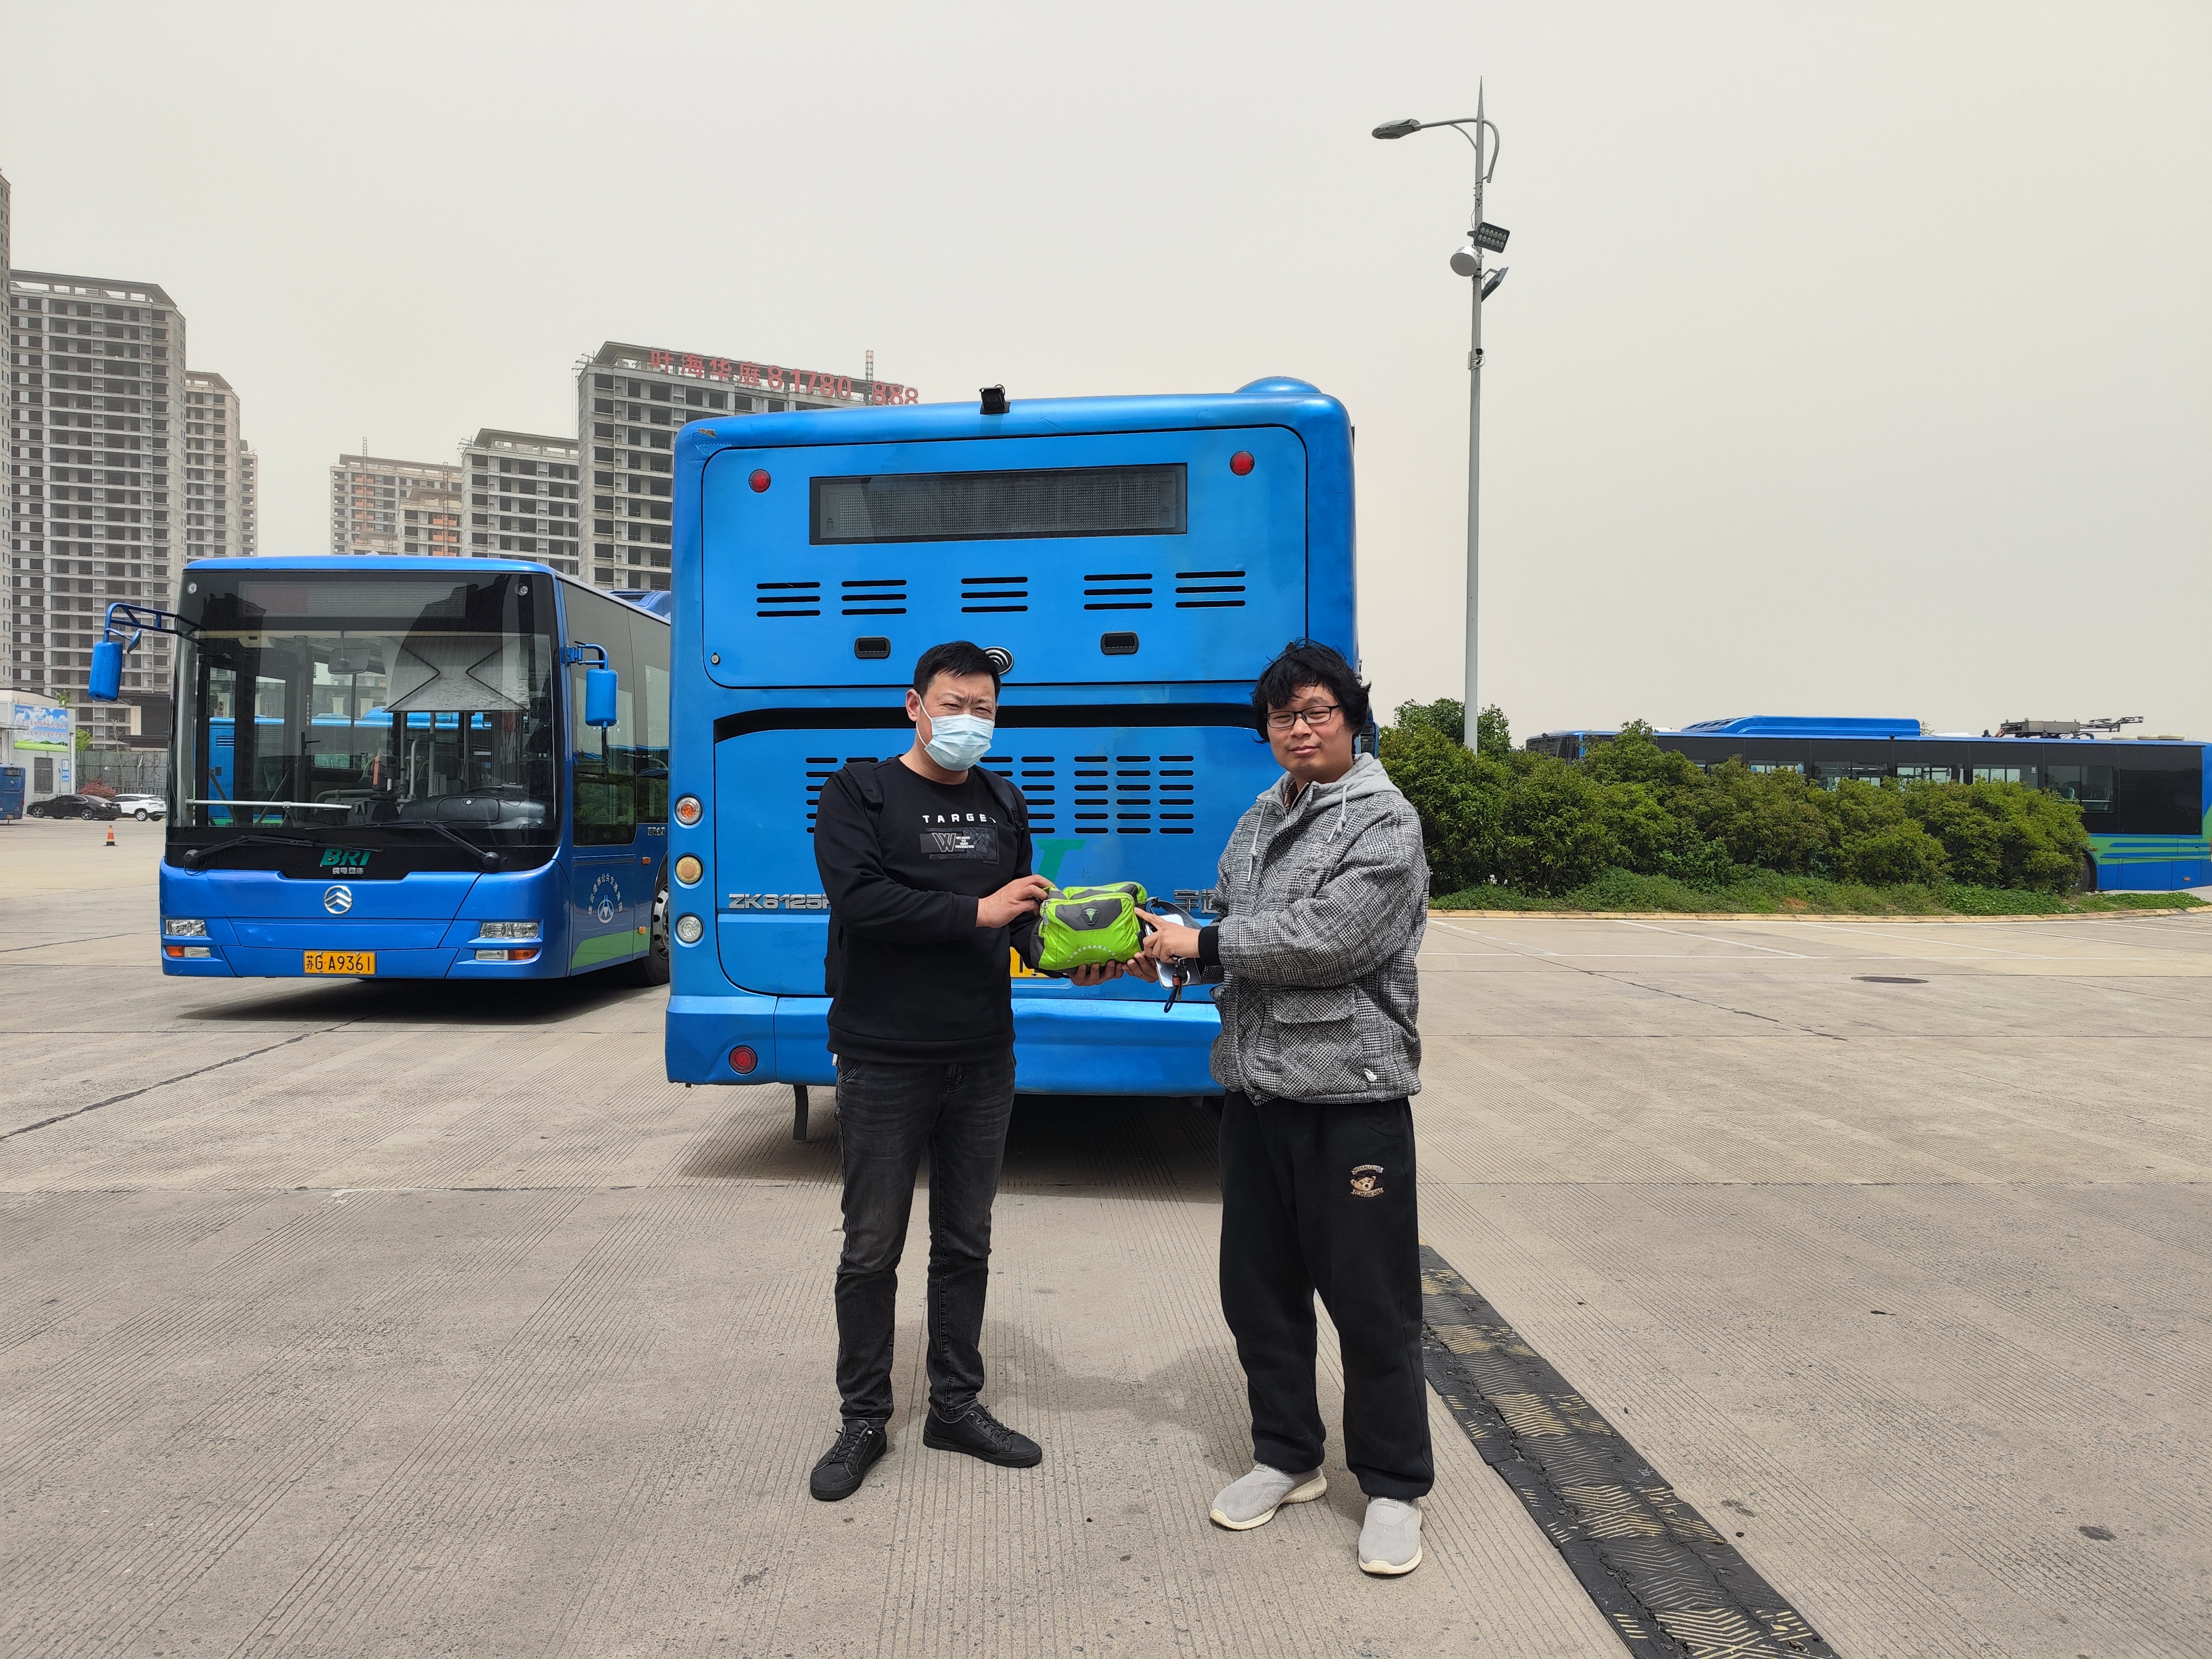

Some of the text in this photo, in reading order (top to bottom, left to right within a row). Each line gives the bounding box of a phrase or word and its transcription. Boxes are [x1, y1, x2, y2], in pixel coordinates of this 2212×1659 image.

[651, 349, 761, 386] 叶海华庭
[767, 365, 852, 399] 81780
